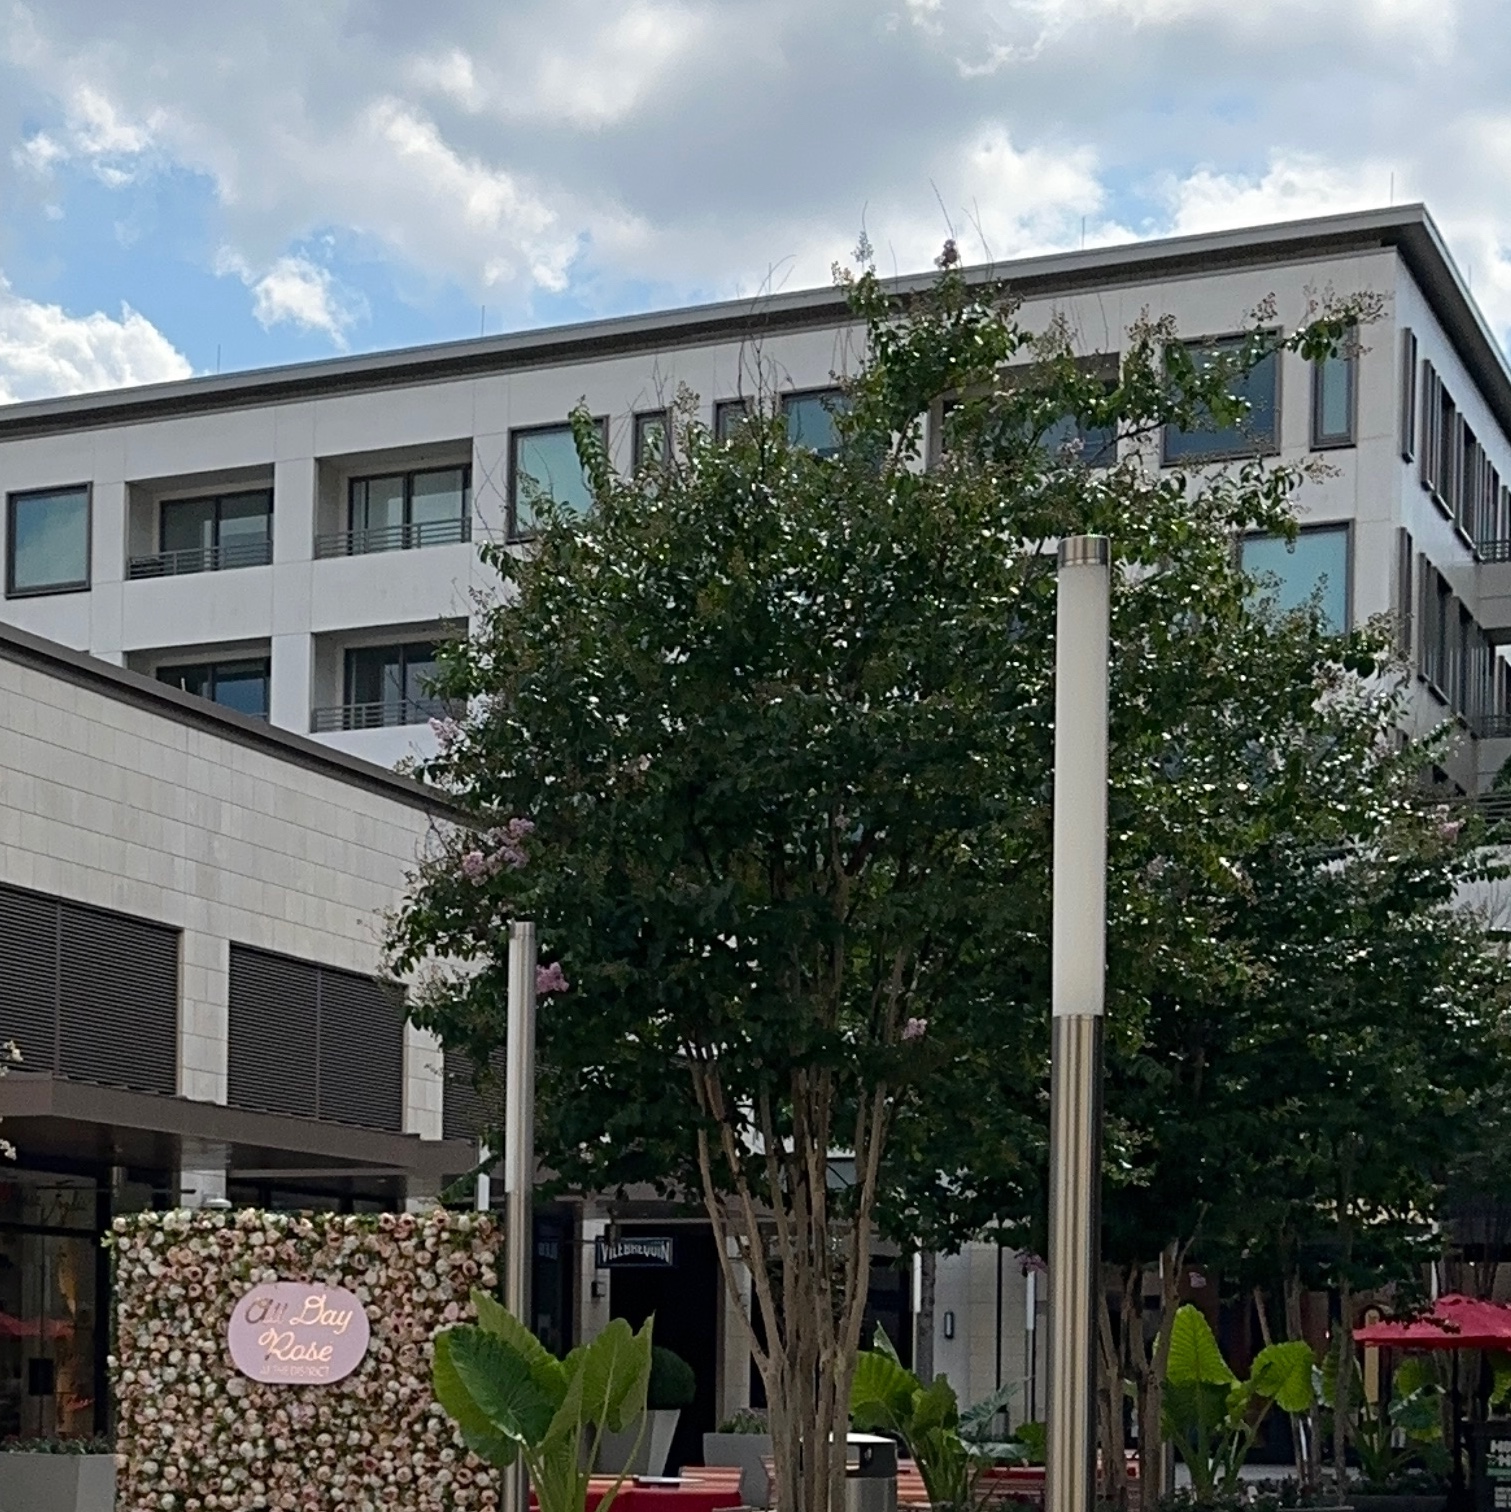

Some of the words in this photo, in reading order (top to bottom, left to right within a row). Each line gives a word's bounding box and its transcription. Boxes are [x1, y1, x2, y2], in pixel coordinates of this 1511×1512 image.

[600, 1240, 671, 1263] VILEBREQUIN
[244, 1296, 289, 1324] All
[289, 1293, 354, 1335] Day
